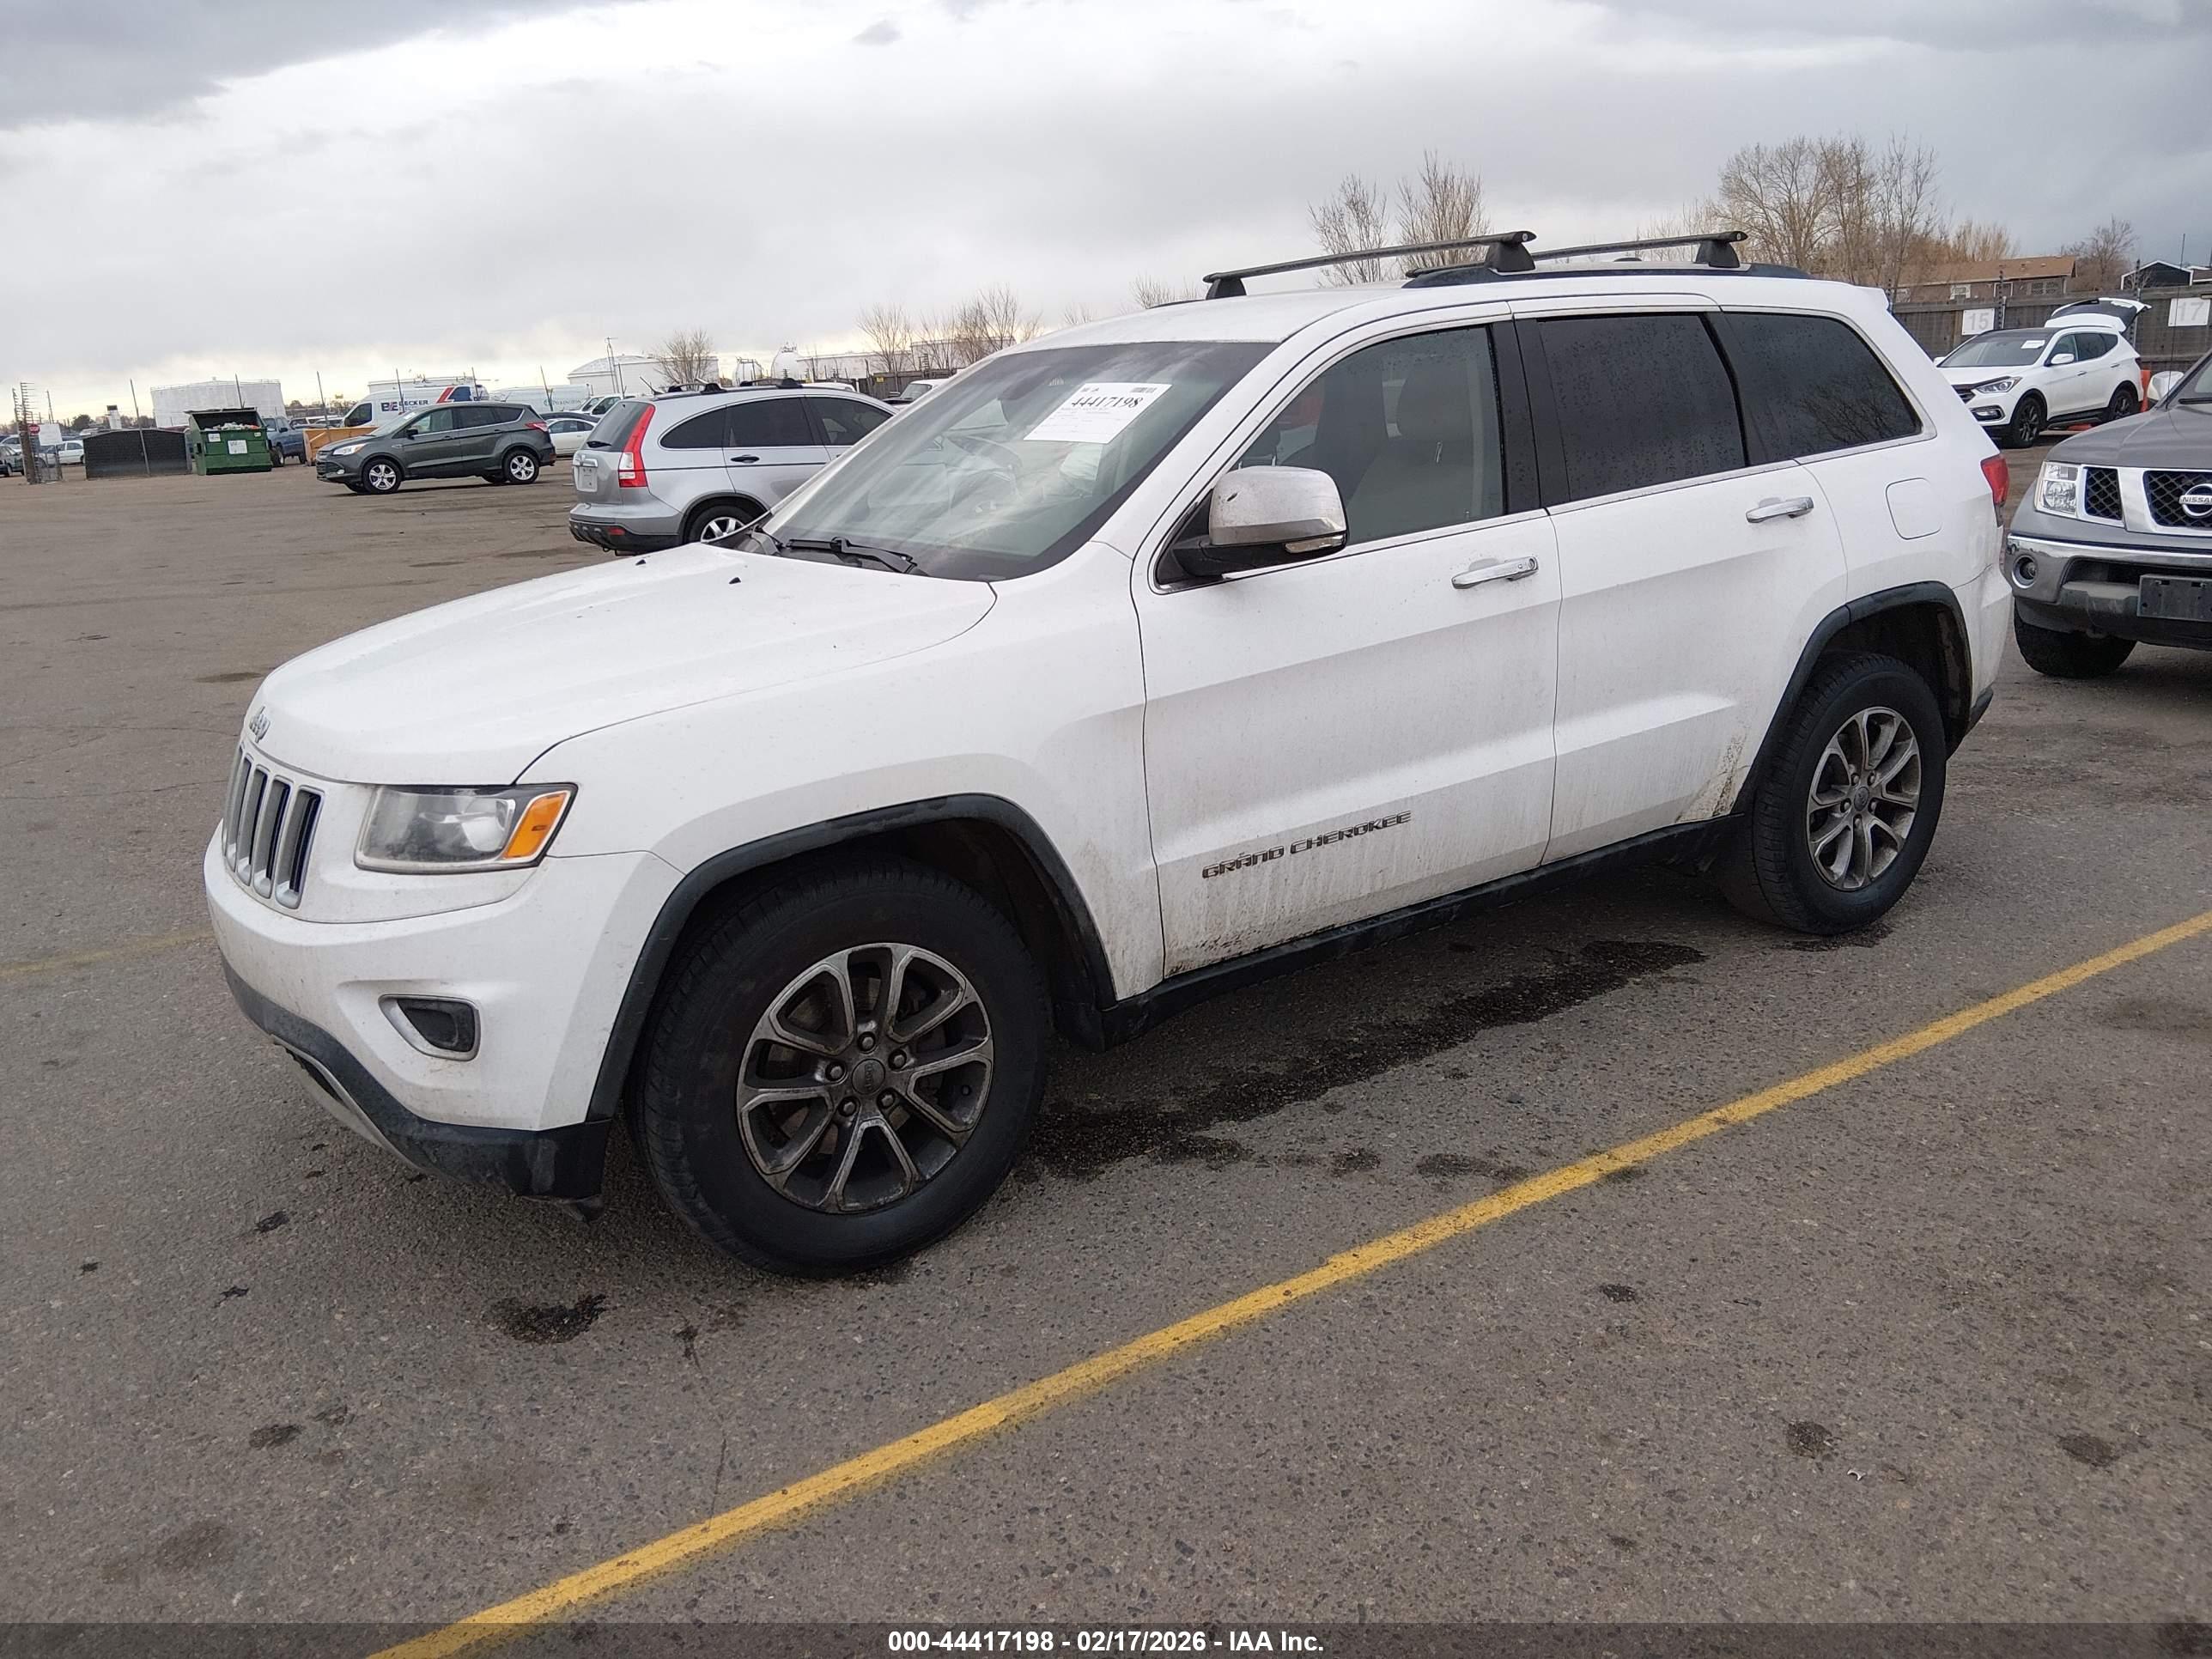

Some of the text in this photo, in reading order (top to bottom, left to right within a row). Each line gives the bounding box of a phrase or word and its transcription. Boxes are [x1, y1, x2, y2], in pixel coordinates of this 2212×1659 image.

[2178, 301, 2204, 322] 17
[1969, 313, 1990, 331] 15
[1071, 396, 1144, 409] 44417198
[1202, 810, 1412, 878] GRAND CHEROKEE
